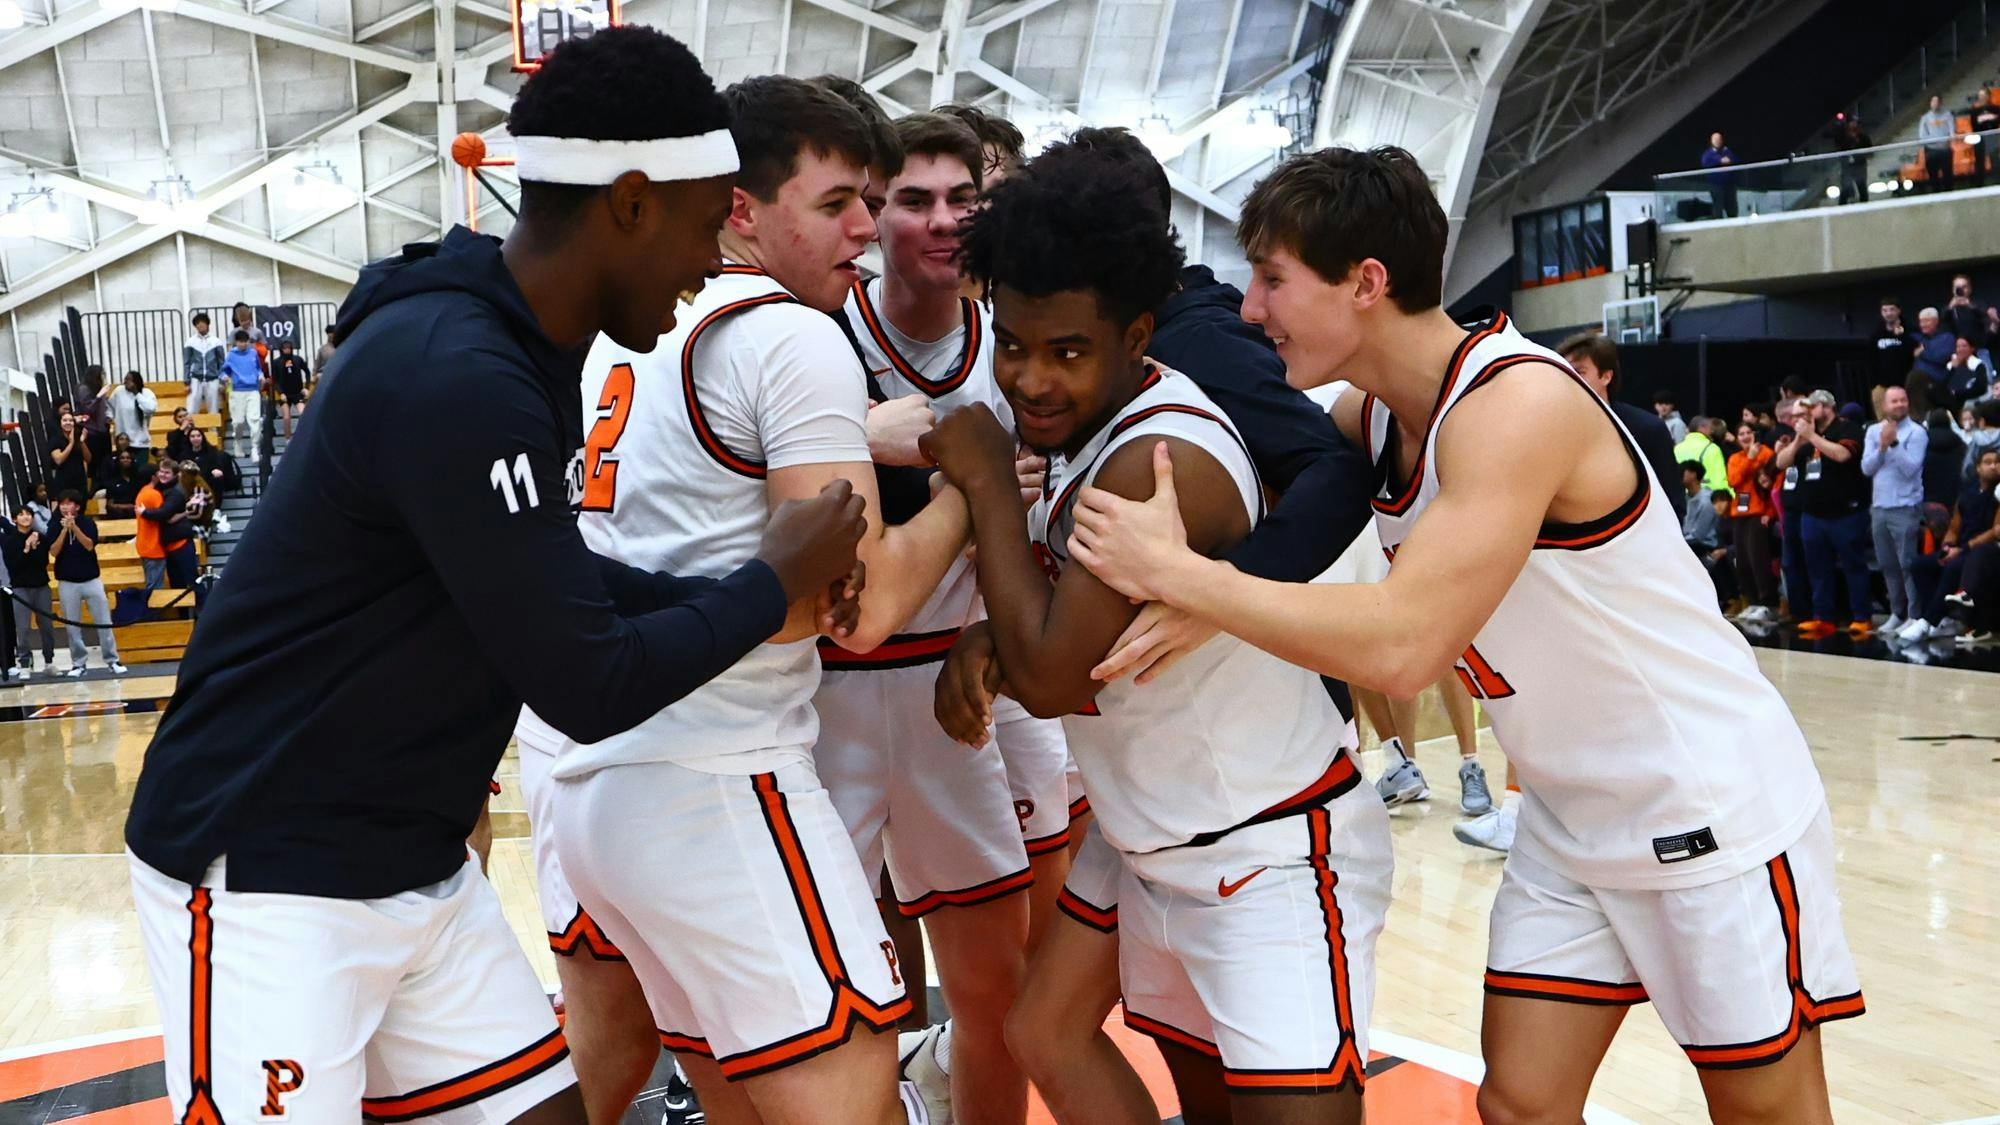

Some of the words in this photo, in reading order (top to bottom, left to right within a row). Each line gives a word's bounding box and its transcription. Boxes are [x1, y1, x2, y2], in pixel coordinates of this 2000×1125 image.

[262, 320, 294, 338] 109
[489, 452, 539, 514] 11
[1695, 839, 1706, 849] L
[879, 940, 902, 986] P
[260, 1059, 304, 1116] P
